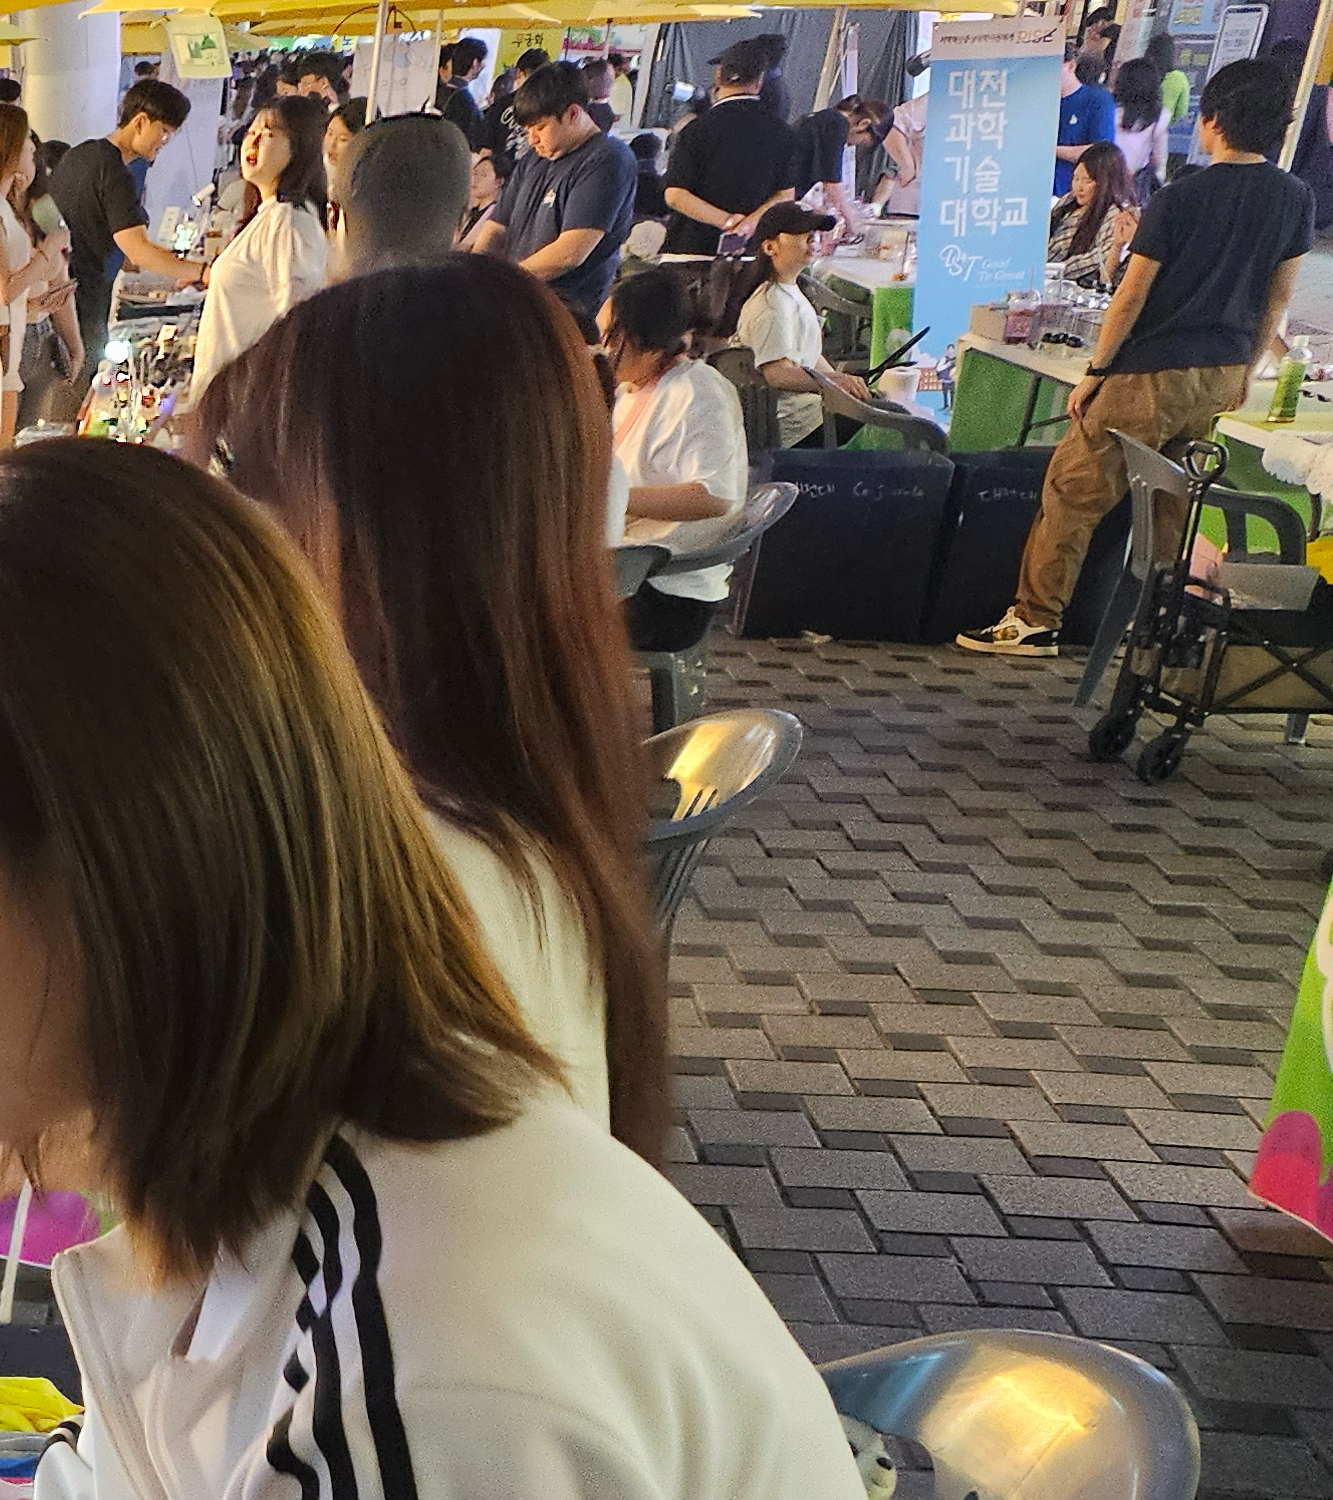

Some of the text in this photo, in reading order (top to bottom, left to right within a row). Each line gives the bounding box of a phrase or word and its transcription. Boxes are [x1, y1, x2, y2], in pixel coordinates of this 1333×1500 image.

[947, 68, 1009, 110] 대전
[944, 110, 1010, 152] 과학
[943, 155, 1002, 195] 기술
[939, 196, 1029, 239] 대학교
